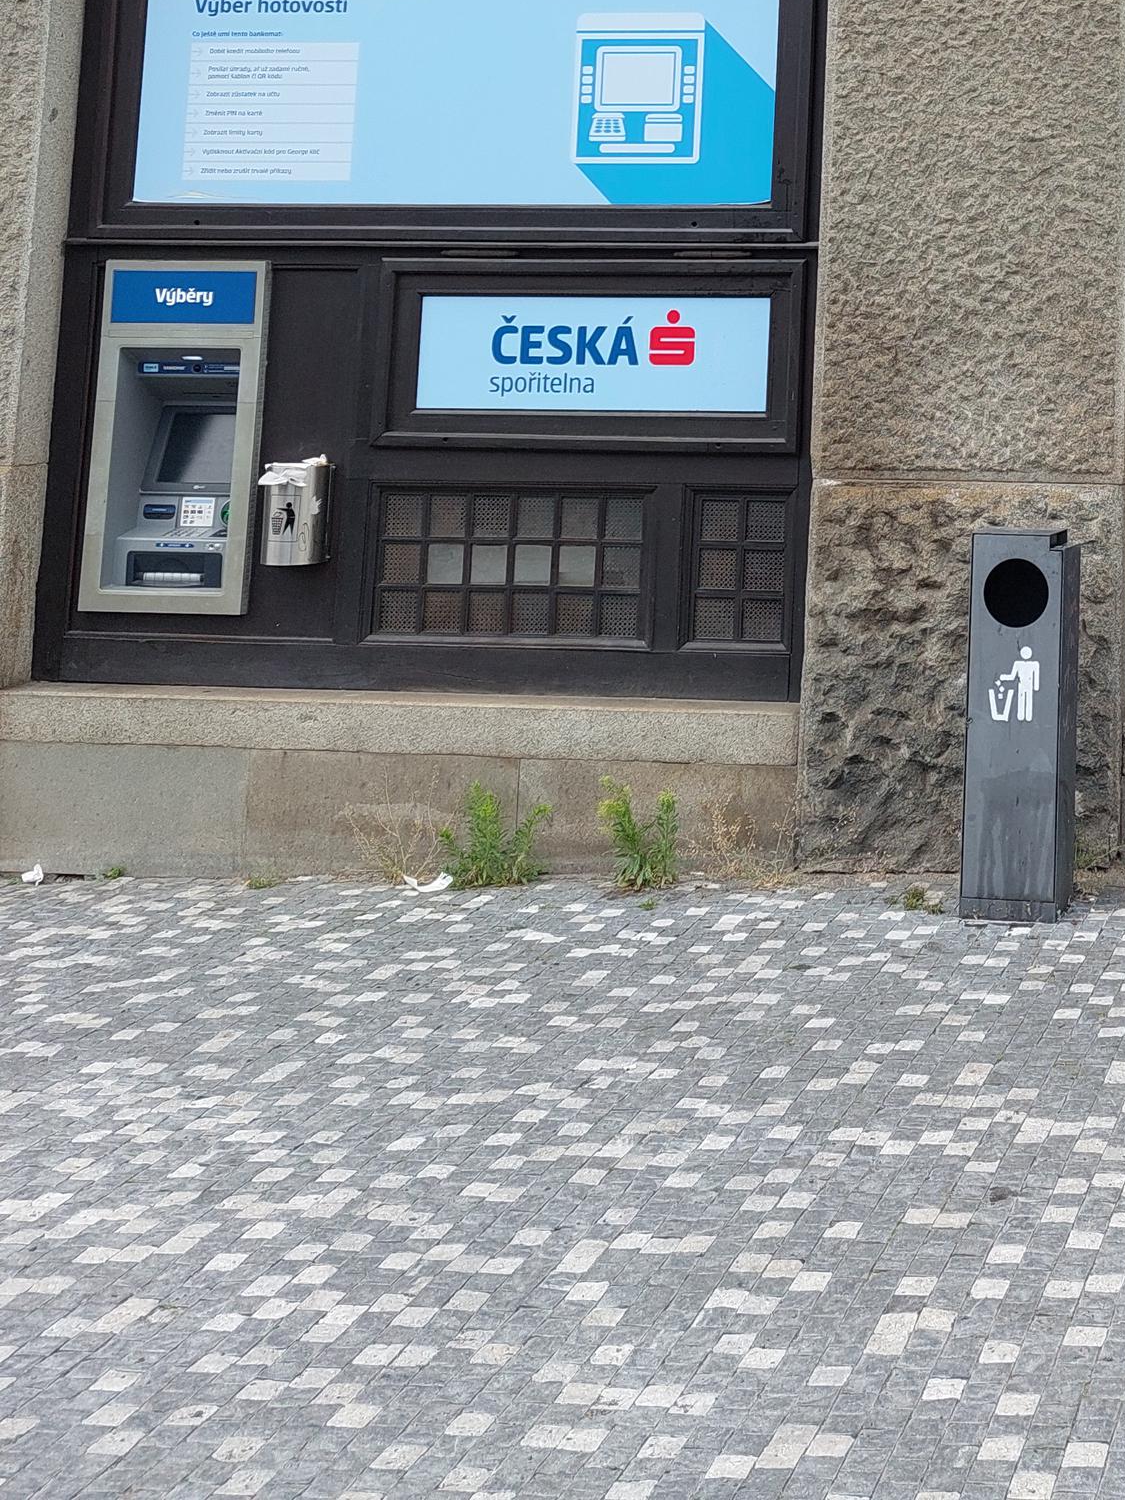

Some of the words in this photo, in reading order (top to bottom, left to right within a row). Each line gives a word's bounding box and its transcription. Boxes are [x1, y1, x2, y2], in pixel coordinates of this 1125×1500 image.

[155, 287, 214, 307] Výběry
[491, 315, 639, 366] ČESKÁ
[489, 372, 595, 397] spořitelna
